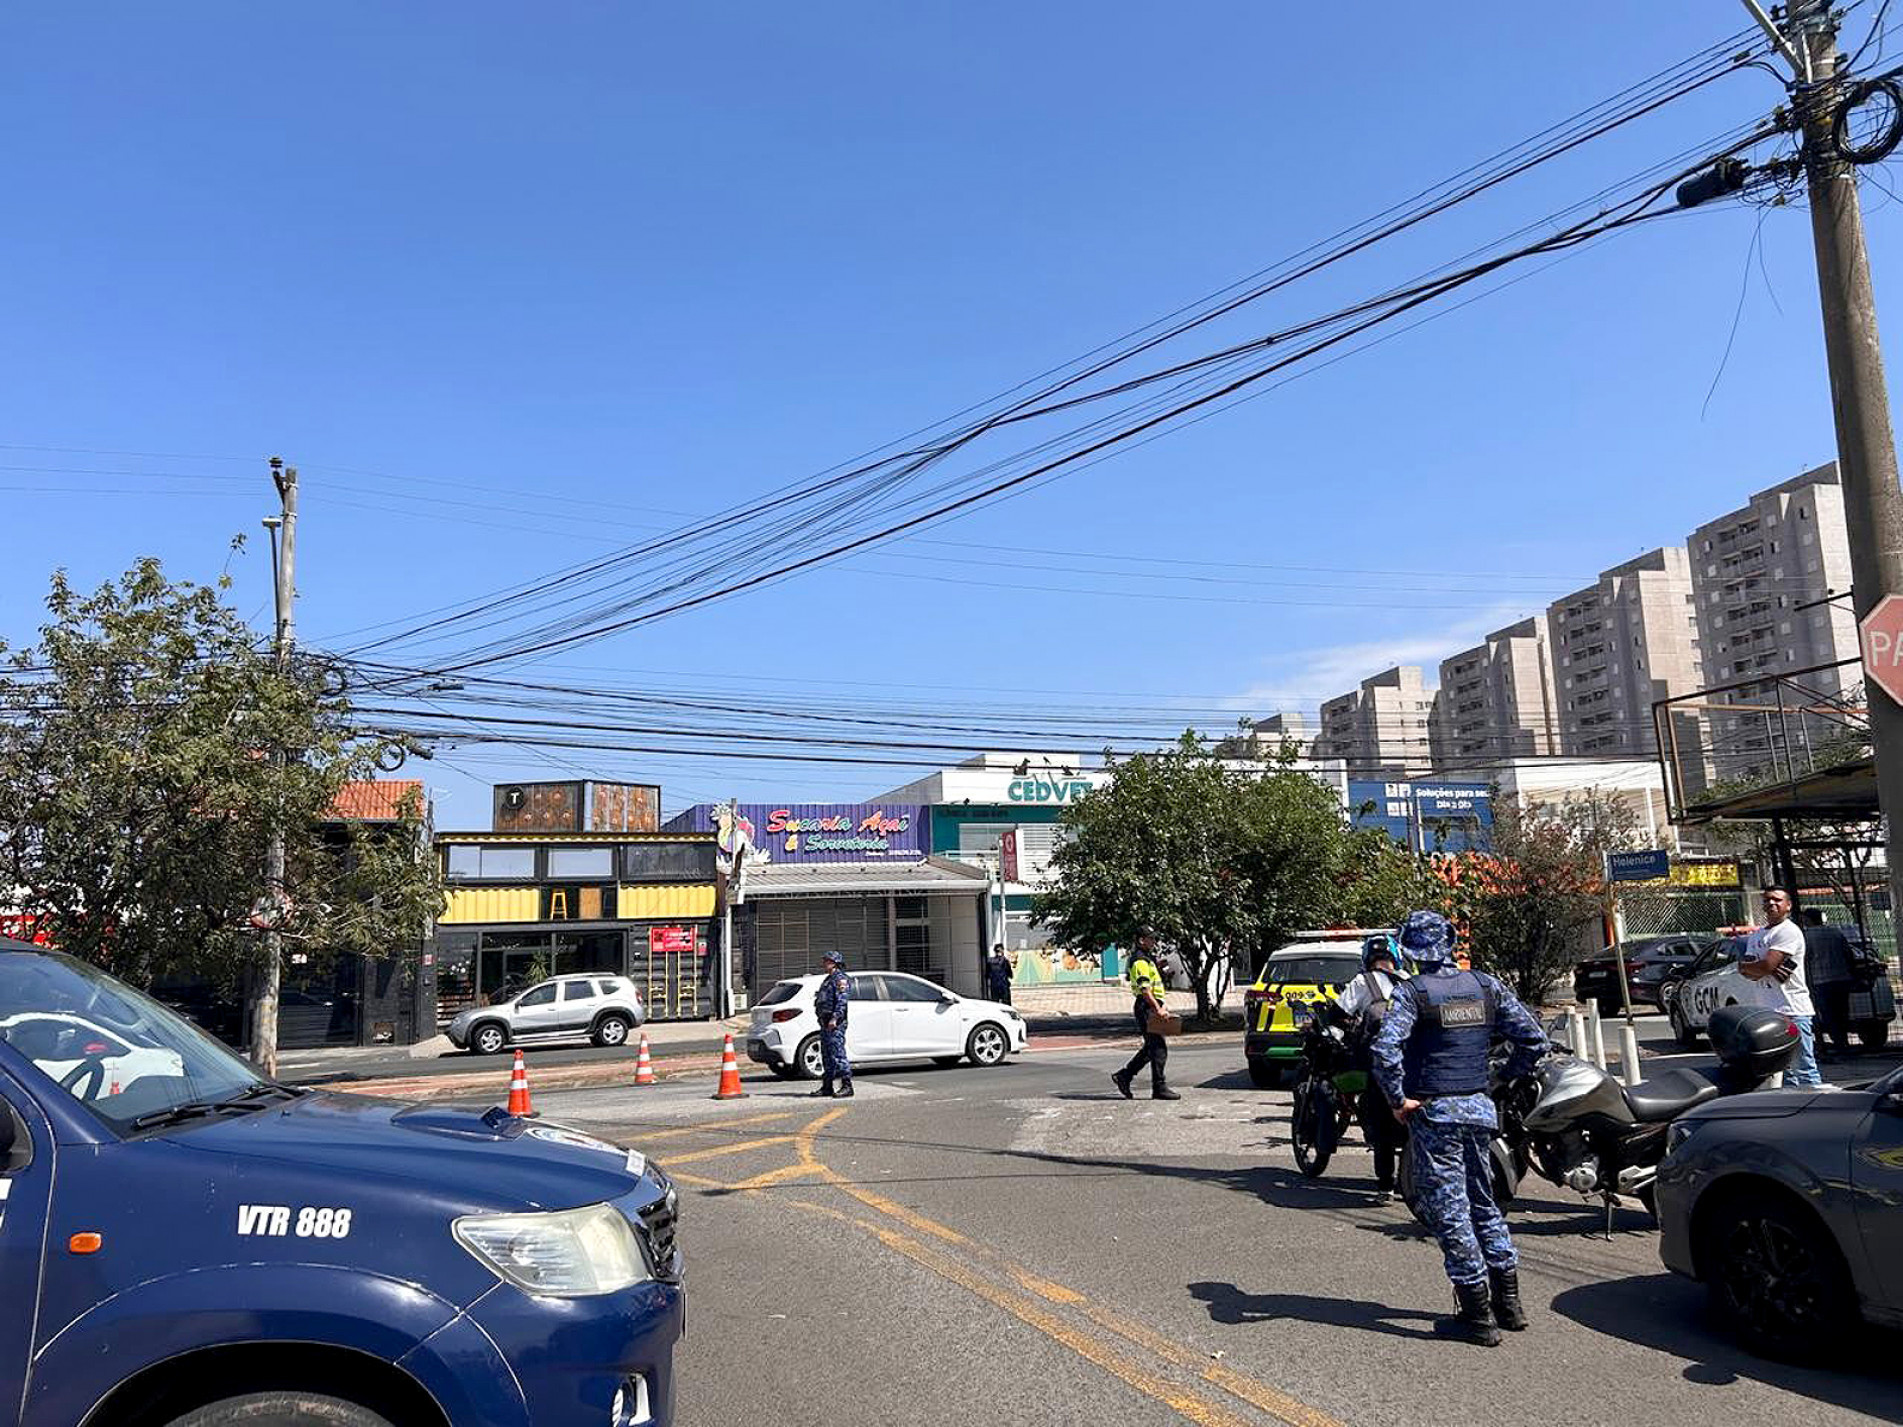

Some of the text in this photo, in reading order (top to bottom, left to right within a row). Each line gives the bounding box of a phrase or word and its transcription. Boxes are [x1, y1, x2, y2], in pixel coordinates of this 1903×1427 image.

[1416, 787, 1453, 799] Soluções
[1455, 790, 1474, 799] para
[238, 1205, 352, 1239] VTR 888
